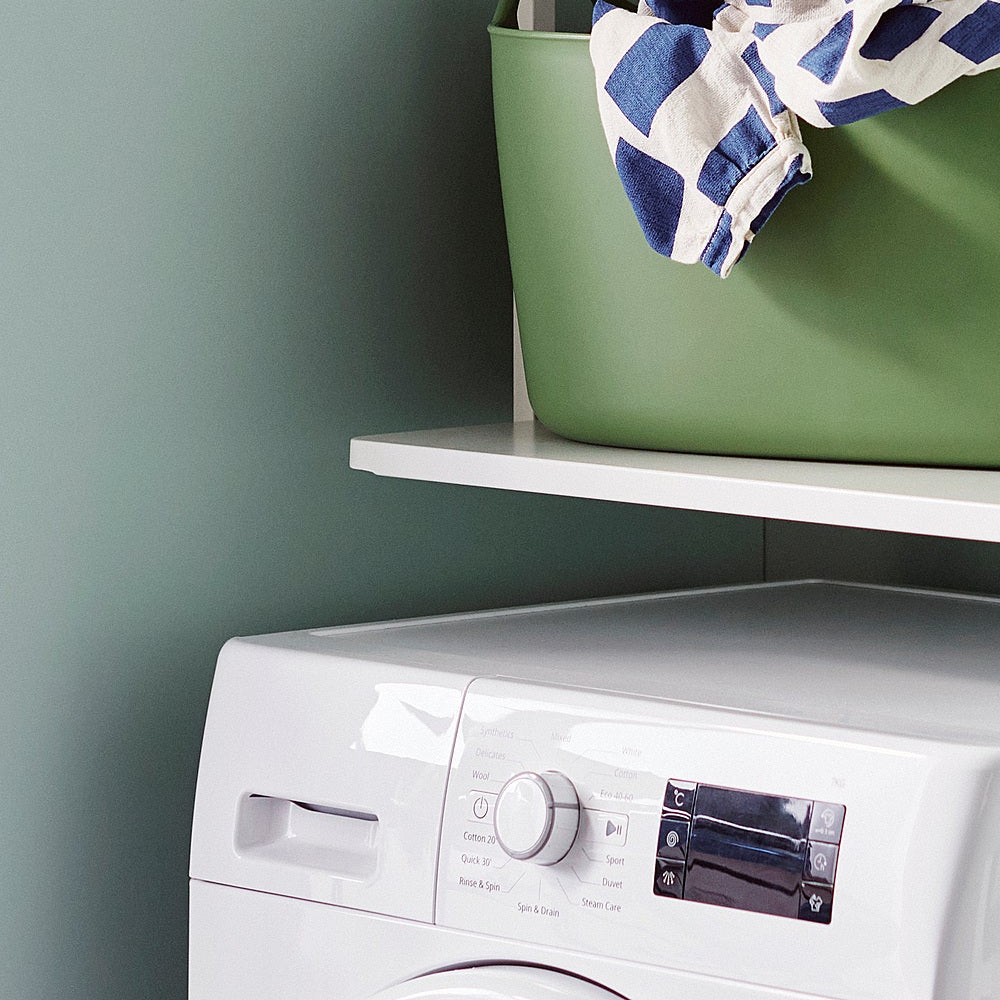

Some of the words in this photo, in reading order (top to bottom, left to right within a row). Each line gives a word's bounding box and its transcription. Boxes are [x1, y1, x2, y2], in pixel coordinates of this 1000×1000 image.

[480, 727, 514, 739] Synthetics
[475, 747, 506, 760] Delicates
[472, 770, 490, 780] Wool
[614, 768, 638, 780] Cotton
[600, 790, 612, 800] Eco
[463, 831, 486, 843] Cotton
[487, 836, 496, 845] 20
[461, 854, 479, 866] Quick
[606, 854, 625, 866] Sport
[459, 876, 478, 888] Rinse
[479, 880, 485, 889] &
[485, 881, 501, 892] Spin
[602, 877, 623, 889] Duvet
[517, 902, 533, 915] Spin
[534, 905, 540, 914] &
[541, 906, 560, 917] Drain
[582, 897, 604, 909] Steam
[604, 901, 622, 912] Care
